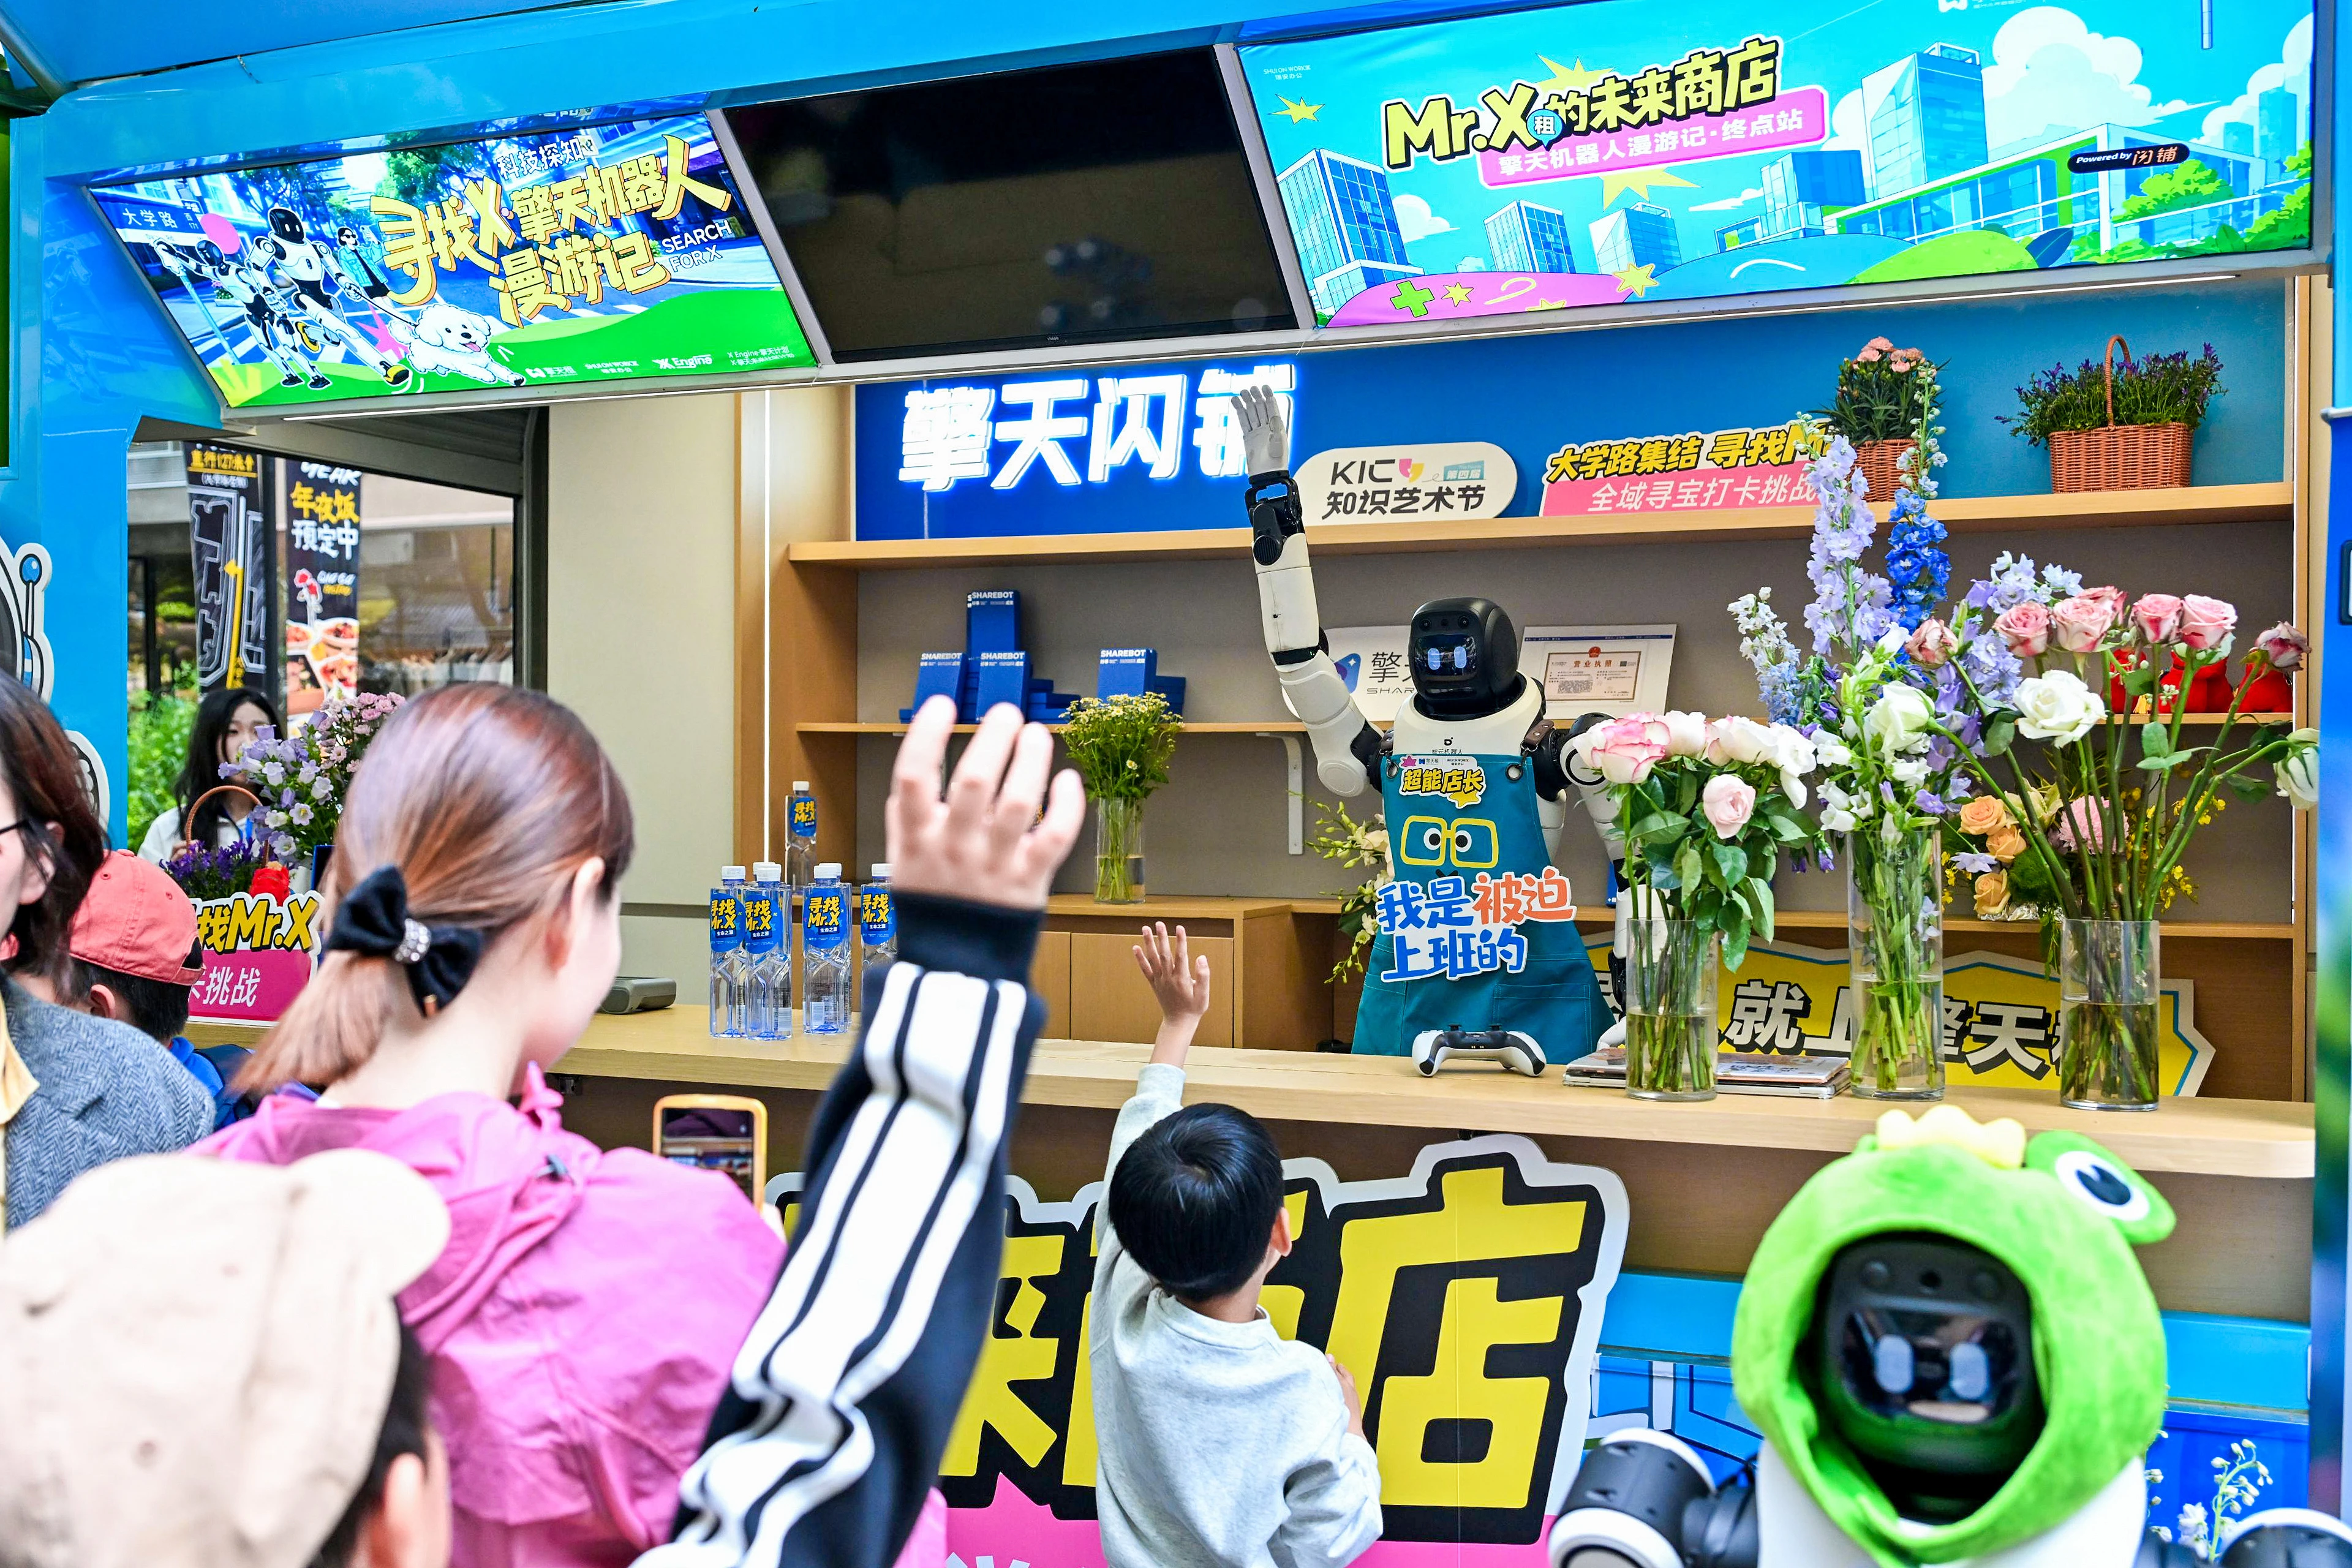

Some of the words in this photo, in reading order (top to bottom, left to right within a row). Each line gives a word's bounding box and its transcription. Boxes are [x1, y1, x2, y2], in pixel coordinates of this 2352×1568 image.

[1533, 115, 1556, 136] 租
[497, 137, 584, 181] 科技探知
[2076, 153, 2117, 164] Powered
[510, 134, 731, 244] 擎天机器人
[123, 208, 178, 228] 大学路
[661, 220, 733, 255] SEARCH
[668, 249, 706, 274] FOR
[708, 244, 724, 263] X
[488, 230, 671, 329] 漫游记
[672, 353, 713, 369] Engine
[1547, 435, 1704, 484] 大学路集结
[1330, 459, 1396, 485] KIC
[290, 481, 360, 524] 年夜饭
[1322, 484, 1486, 521] 知识艺术节
[1100, 649, 1146, 658] SHAREBOT
[1574, 659, 1612, 668] 营业执照
[1402, 767, 1484, 794] 超能店长
[710, 898, 736, 917] 寻找
[745, 899, 771, 918] 寻找
[809, 895, 840, 914] 寻找
[862, 893, 890, 910] 寻找
[1378, 868, 1574, 932] 我是被迫
[807, 910, 841, 928] Mr.X
[862, 908, 891, 924] Mr.X
[1383, 927, 1526, 981] 上班的
